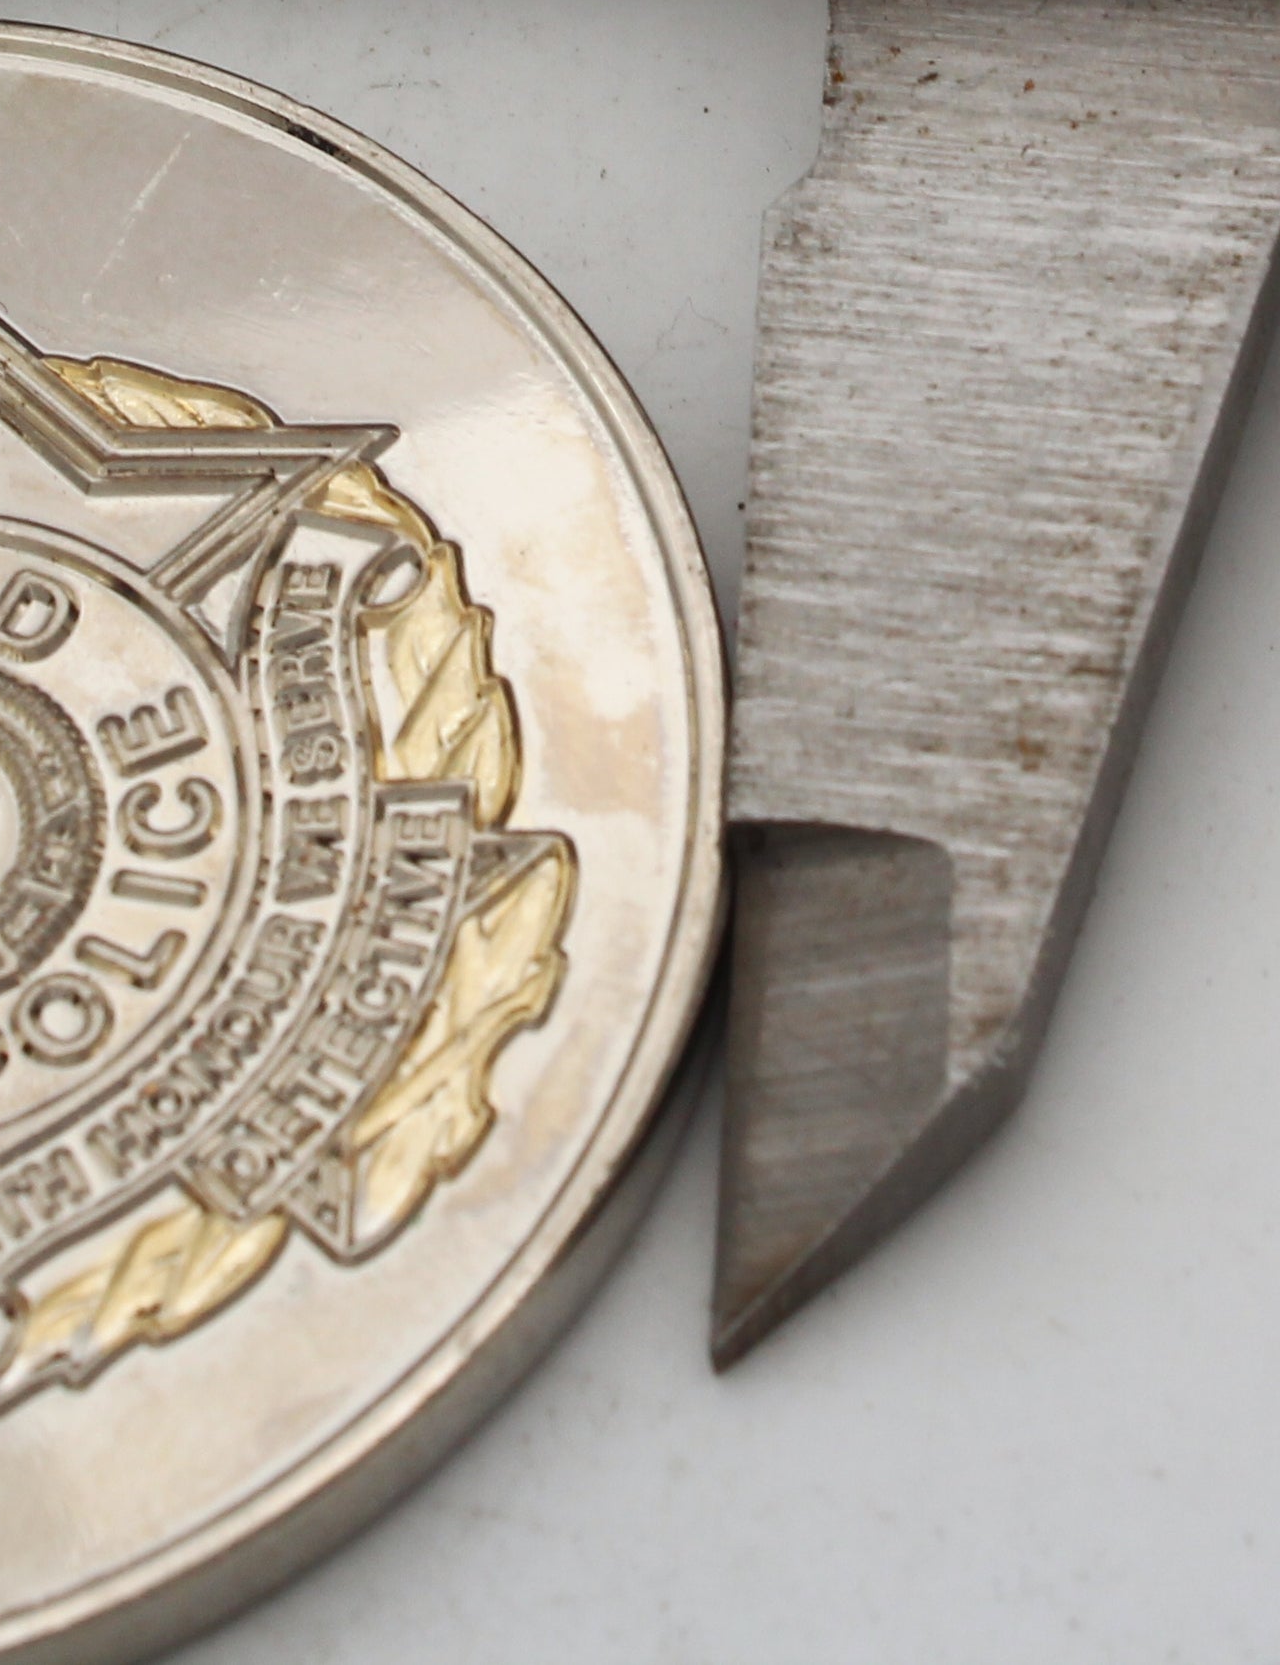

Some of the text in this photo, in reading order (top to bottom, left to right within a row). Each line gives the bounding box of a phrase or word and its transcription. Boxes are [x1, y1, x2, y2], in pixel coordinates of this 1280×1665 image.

[264, 560, 342, 788] SERVE
[274, 794, 351, 905] WE
[85, 913, 320, 1179] HONOUR
[223, 809, 452, 1204] DETECTIVE
